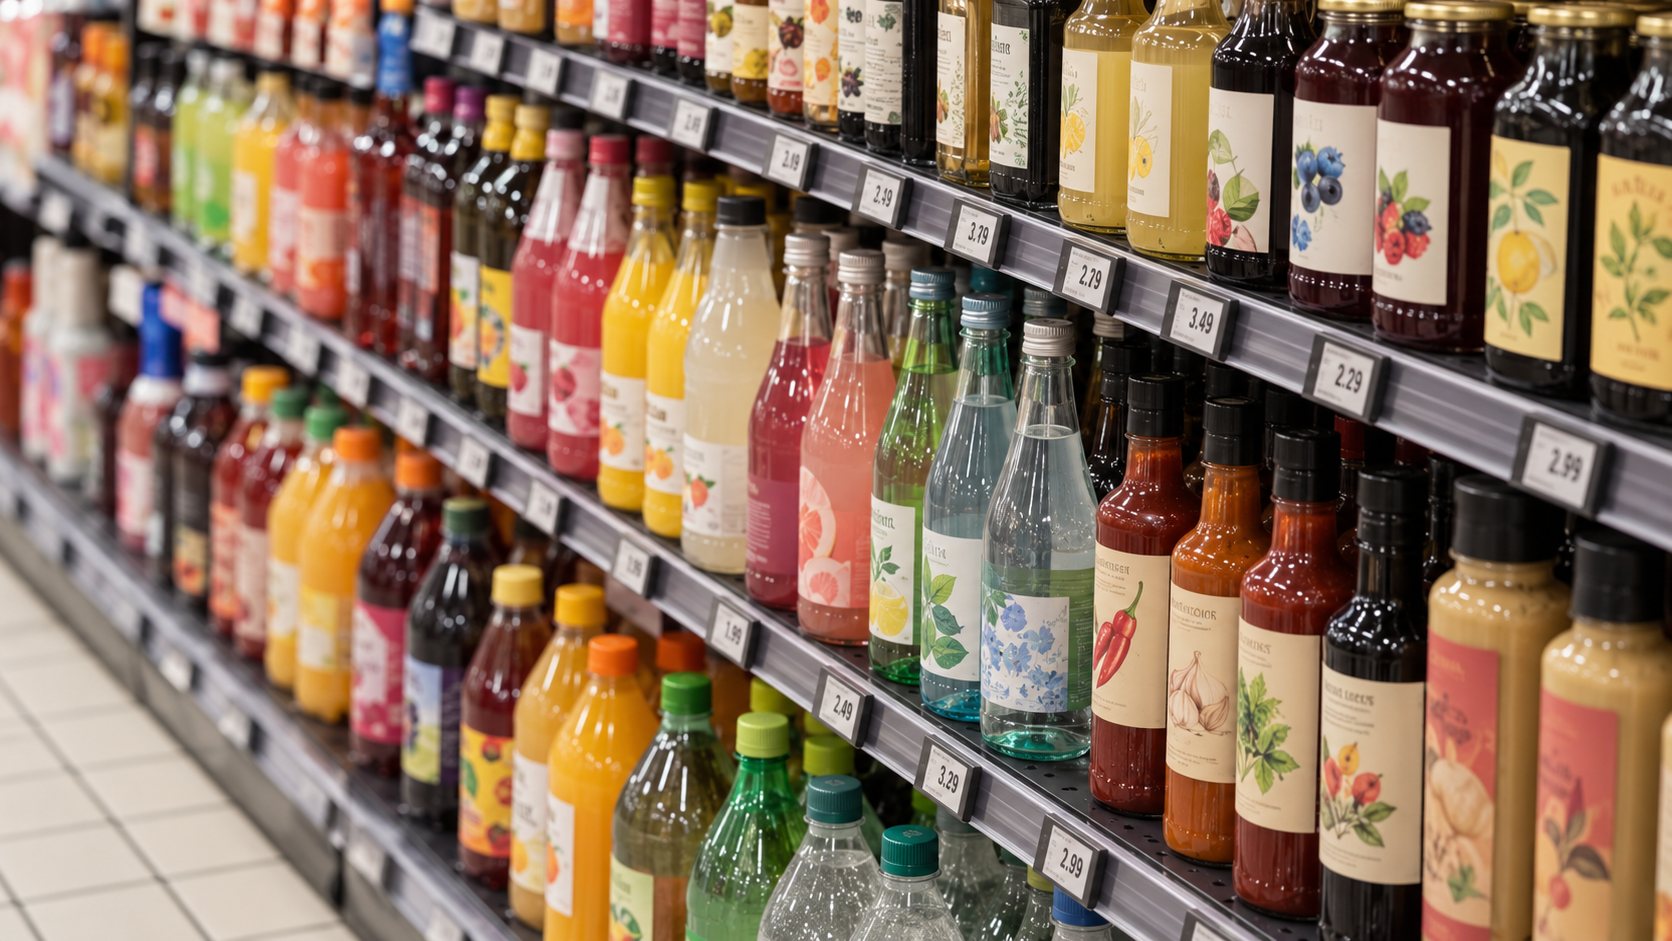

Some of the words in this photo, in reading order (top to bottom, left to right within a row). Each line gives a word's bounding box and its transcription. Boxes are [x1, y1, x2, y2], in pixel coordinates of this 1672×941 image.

[873, 185, 893, 208] 2.49
[1079, 264, 1102, 290] 2.79
[1189, 307, 1214, 334] 3.49
[1335, 363, 1363, 393] 2.29
[1548, 448, 1584, 483] 2.99
[725, 621, 742, 645] 1.99
[833, 694, 853, 721] 2.49
[938, 765, 959, 793] 3.29
[1060, 848, 1083, 878] 2.99
